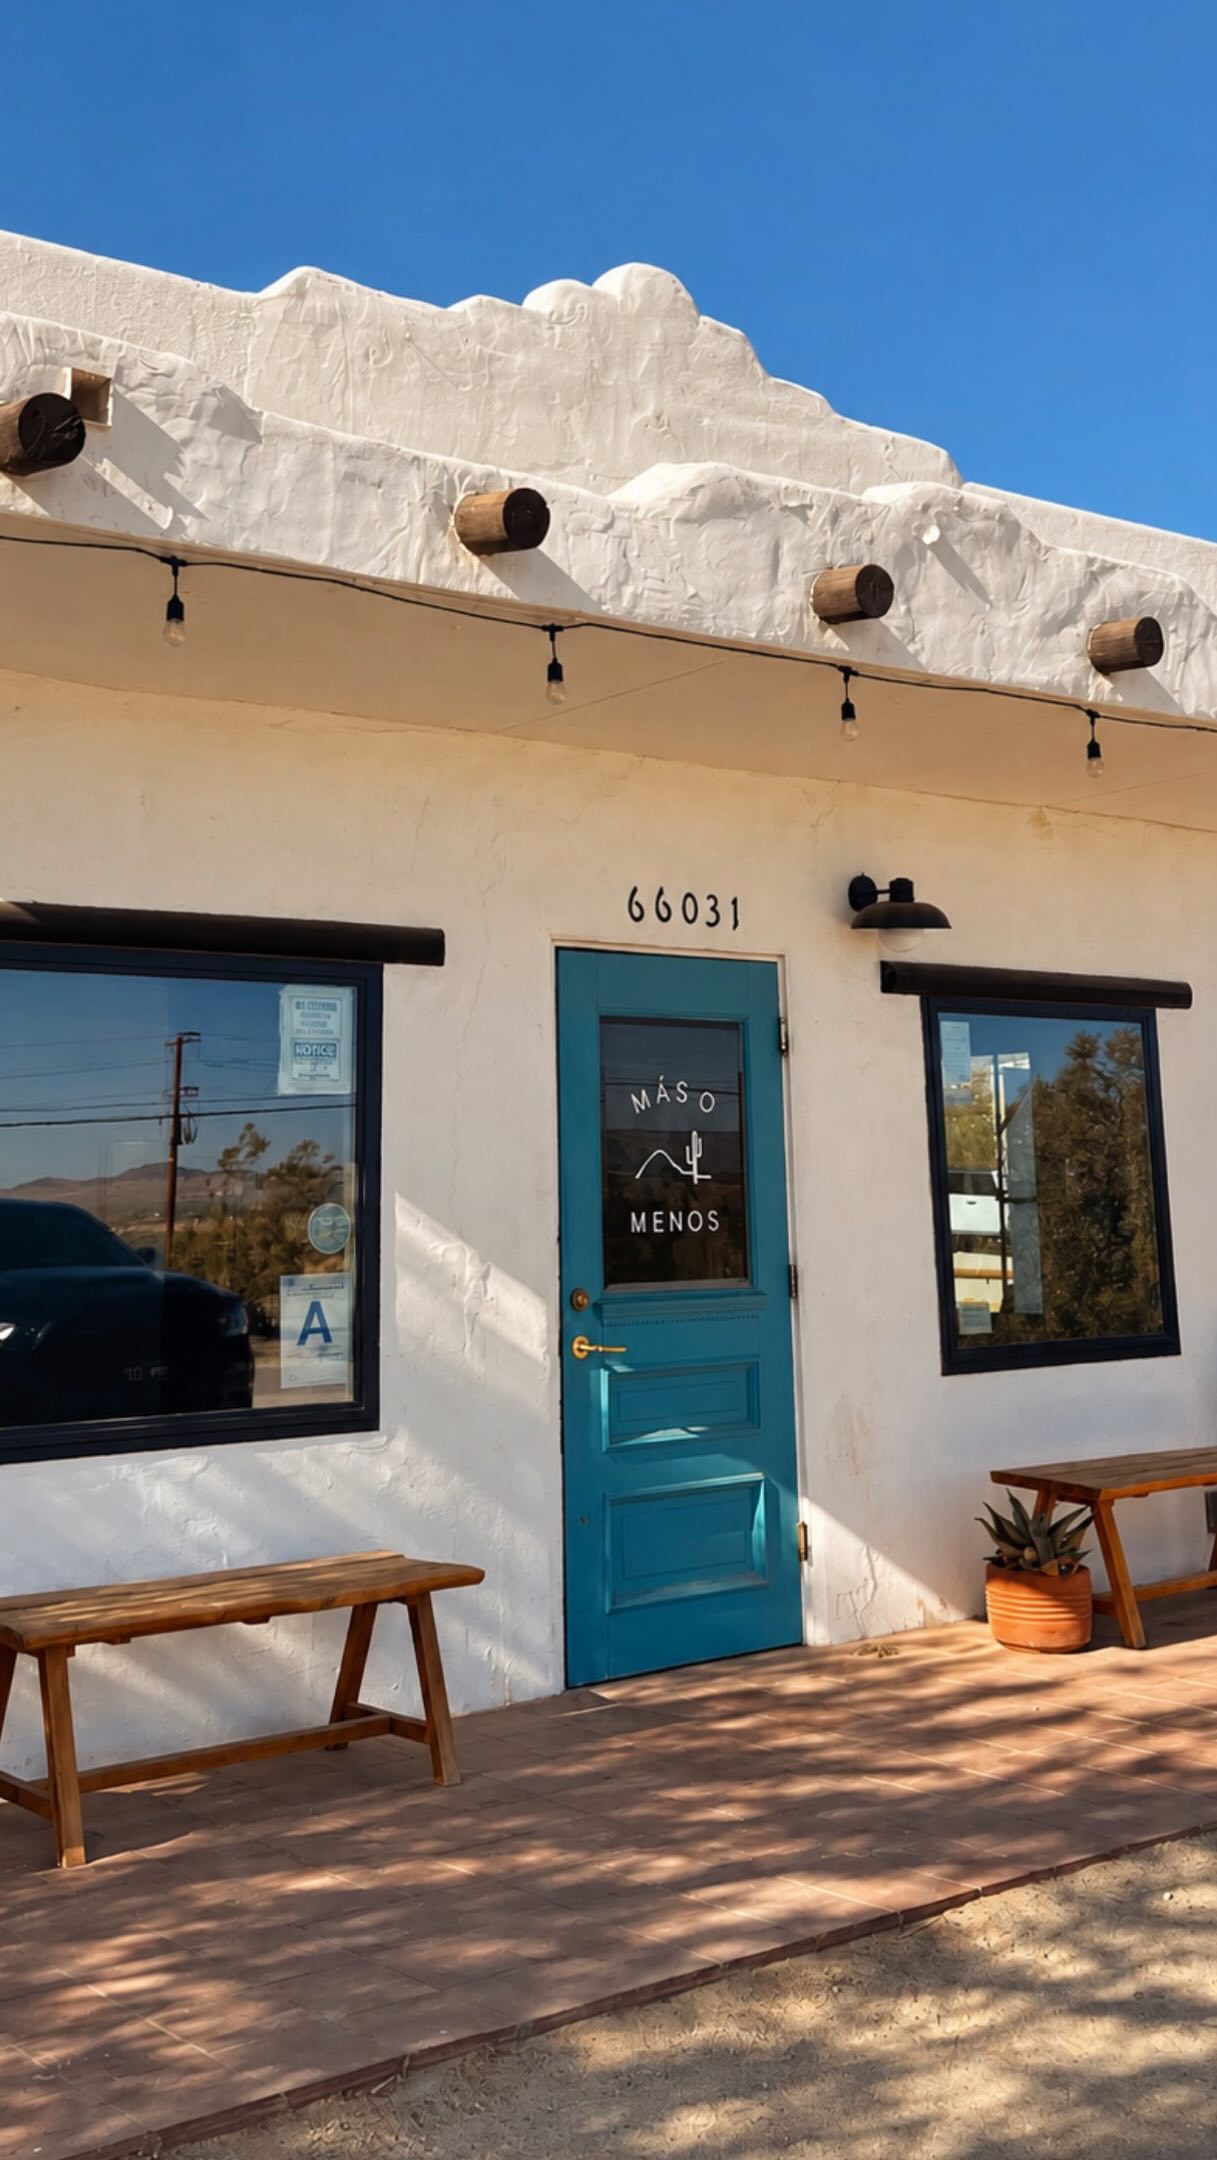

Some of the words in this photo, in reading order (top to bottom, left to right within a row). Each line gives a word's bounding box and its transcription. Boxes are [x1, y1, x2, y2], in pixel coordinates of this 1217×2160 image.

[627, 885, 740, 931] 66031
[630, 1074, 689, 1115] MÁS
[699, 1091, 716, 1114] O
[630, 1210, 720, 1233] MENOS
[296, 1300, 333, 1346] A
